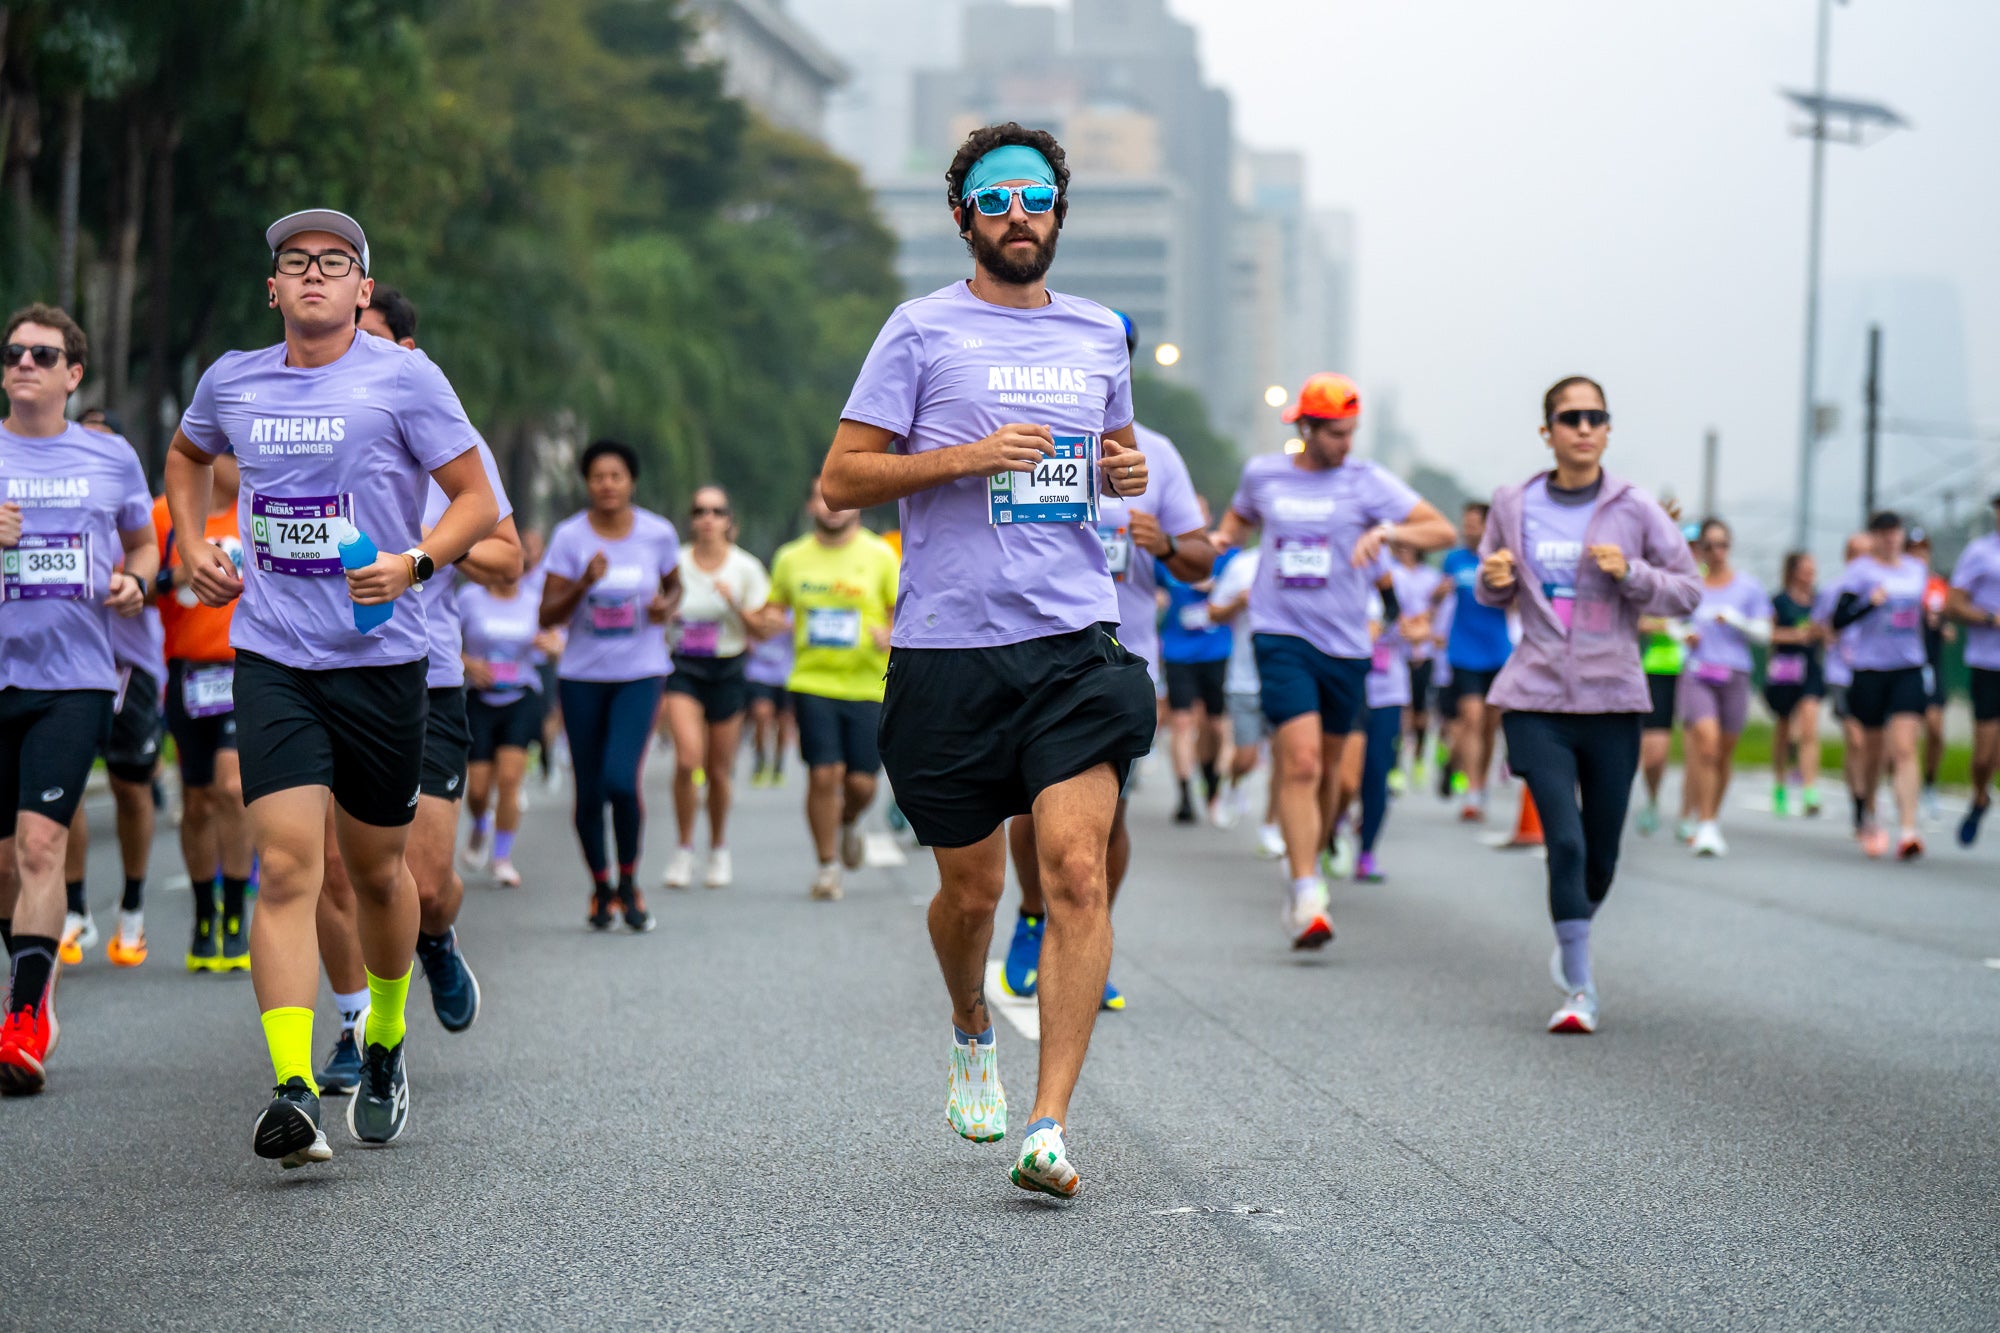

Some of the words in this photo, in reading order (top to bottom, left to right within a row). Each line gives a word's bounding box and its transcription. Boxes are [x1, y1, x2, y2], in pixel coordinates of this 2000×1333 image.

[988, 366, 1087, 392] ATHENAS
[1000, 393, 1026, 403] RUN
[1029, 394, 1078, 404] LONGER
[250, 417, 346, 443] ATHENAS
[259, 444, 284, 455] RUN
[287, 443, 333, 455] LONGER
[1030, 464, 1078, 487] 1442
[7, 478, 90, 498] ATHENAS
[41, 498, 81, 508] LONGER
[994, 495, 1009, 504] 28K
[1039, 495, 1070, 503] GUSTAVO
[265, 503, 295, 516] ATHENAS
[255, 521, 264, 538] C
[276, 523, 329, 545] 7424
[29, 553, 76, 571] 3833
[290, 551, 321, 559] RICARDO
[6, 556, 16, 571] C
